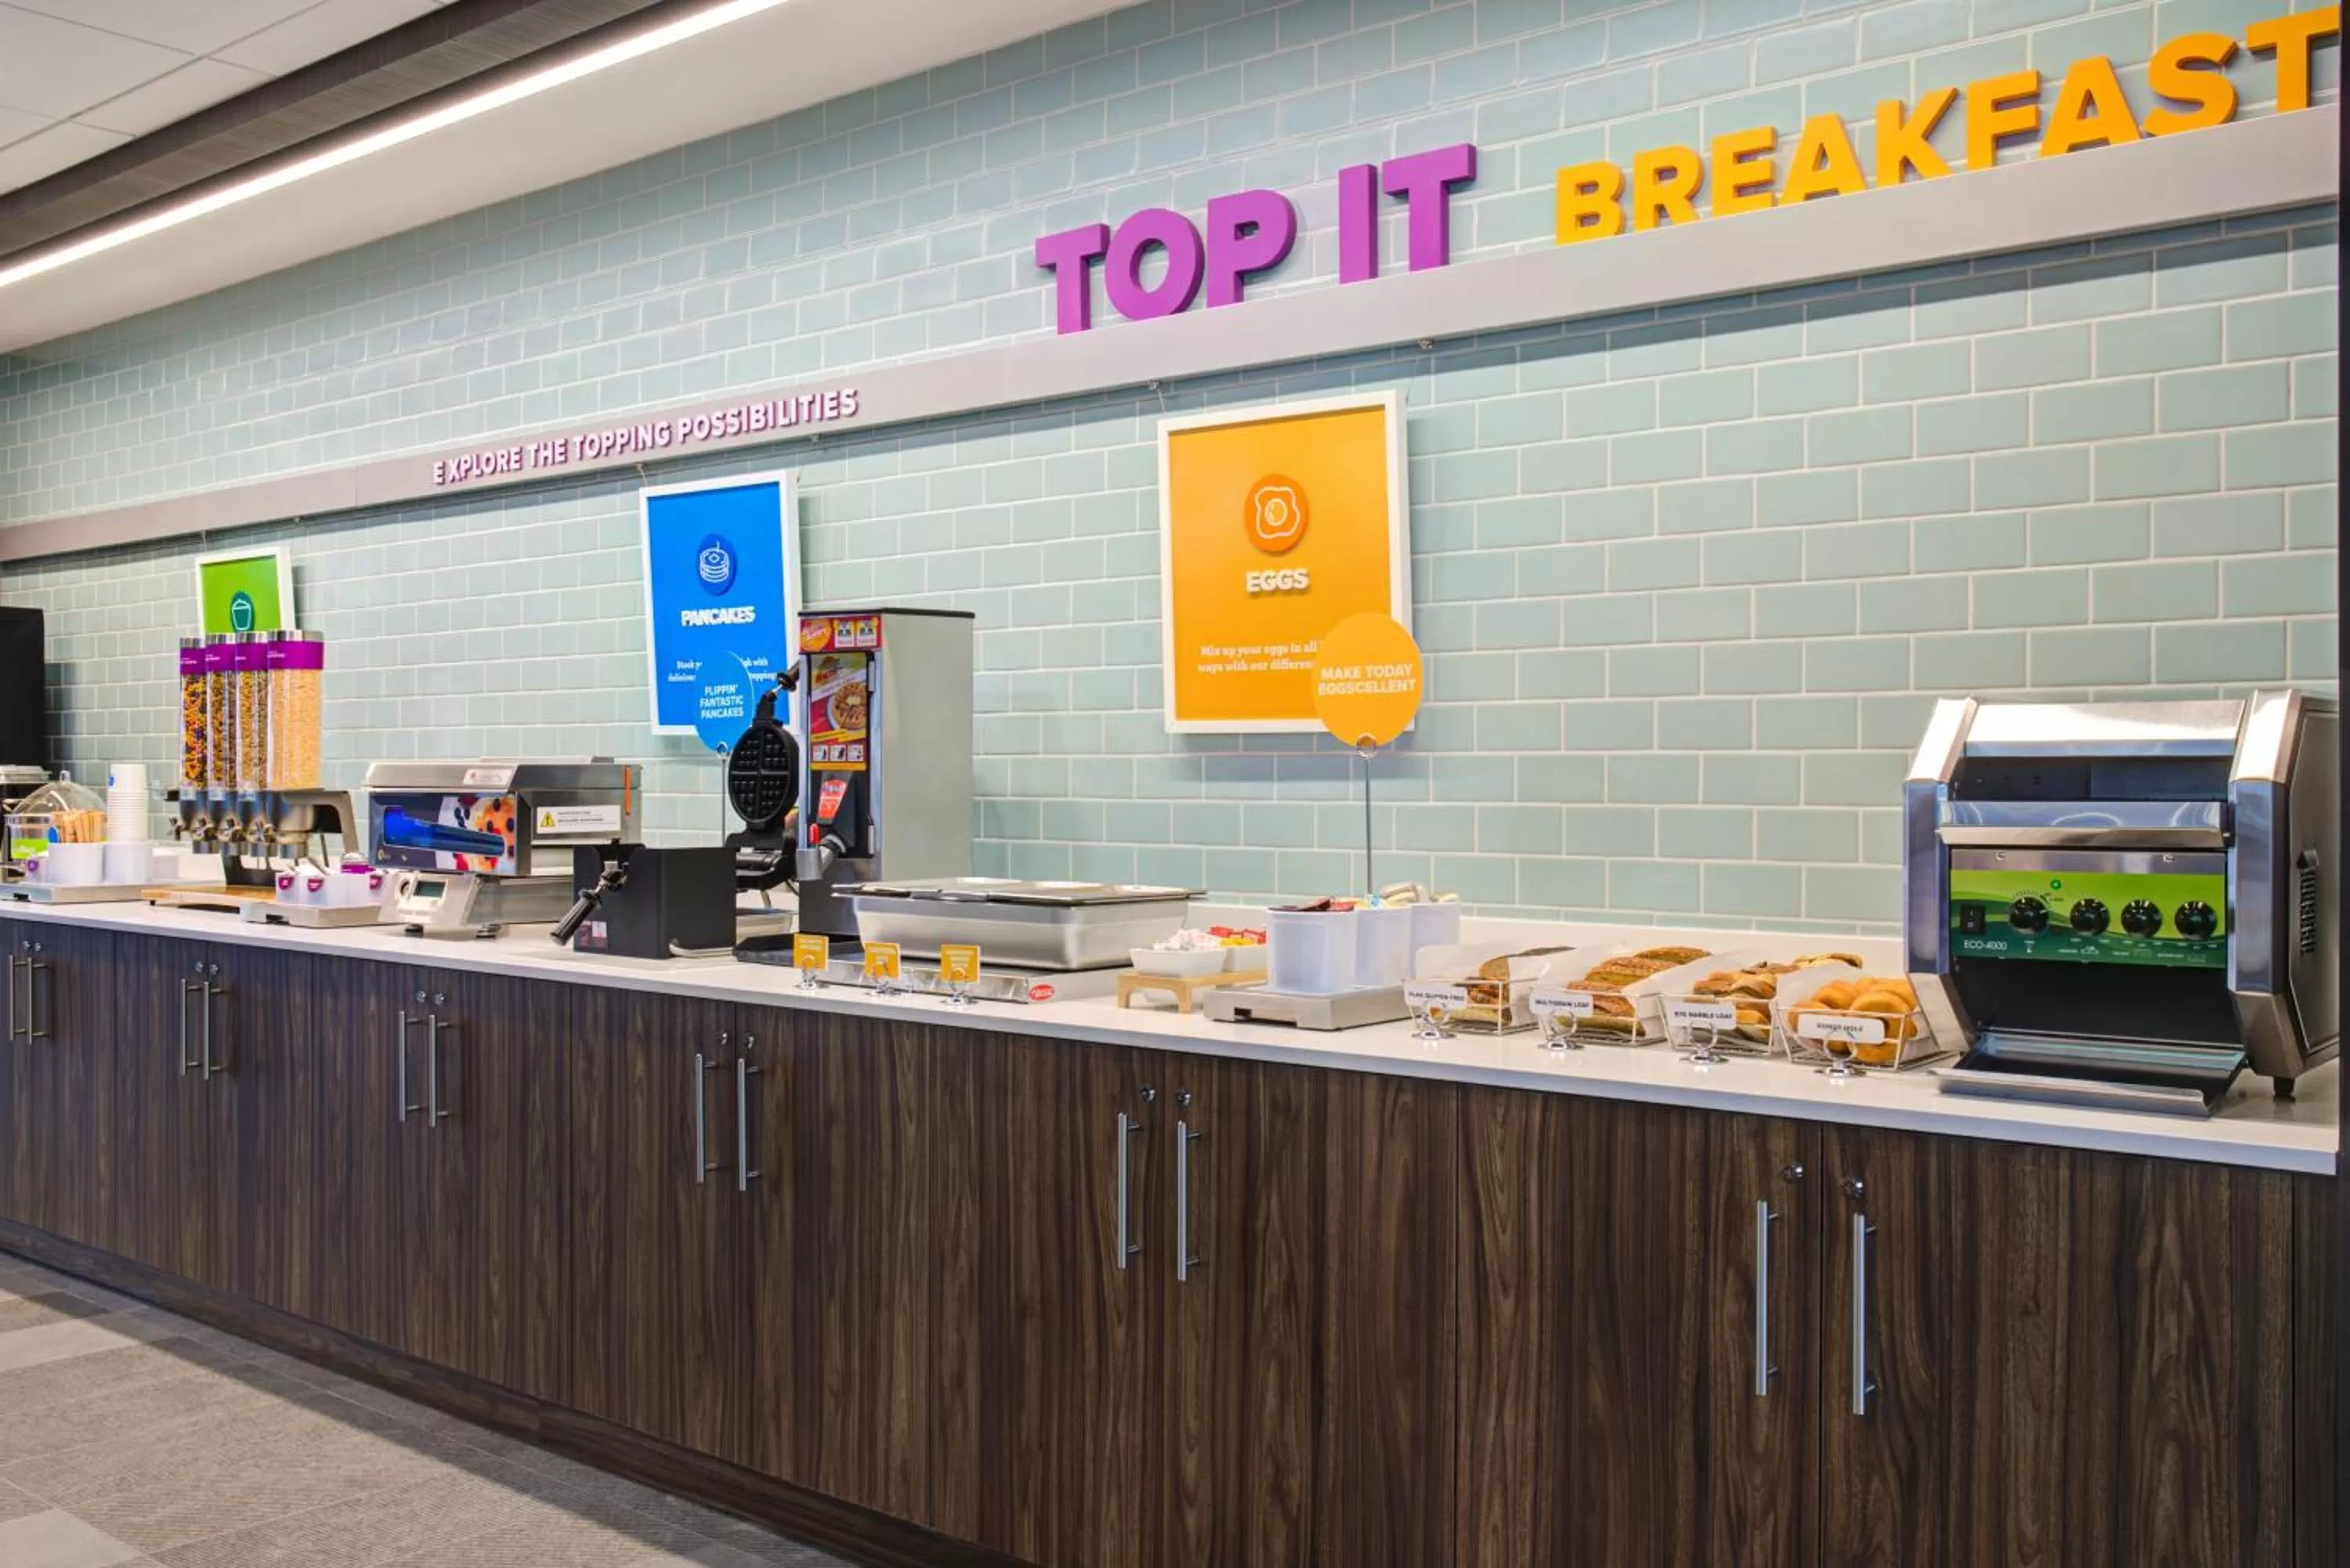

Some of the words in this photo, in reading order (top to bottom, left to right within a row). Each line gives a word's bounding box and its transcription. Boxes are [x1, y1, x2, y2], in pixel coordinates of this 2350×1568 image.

[1555, 4, 2340, 245] BREAKFAST
[1036, 189, 1297, 335] TOP
[1339, 143, 1477, 284] IT
[526, 435, 568, 468] THE
[573, 420, 673, 459] TOPPING
[677, 388, 860, 444] POSSIBILITIES
[1246, 569, 1310, 593] EGGS
[681, 605, 757, 627] PANCAKES
[1222, 647, 1235, 657] up
[1236, 645, 1262, 657] your
[1264, 645, 1288, 657] eggs
[1290, 642, 1302, 653] in
[1198, 661, 1224, 674] ways
[1225, 659, 1249, 671] with
[1250, 661, 1267, 671] our
[1321, 666, 1361, 681] MAKE
[1365, 664, 1413, 678] TODAY
[1318, 679, 1417, 696] EGGSCELLENT
[700, 695, 744, 708] FANTASTIC
[701, 706, 743, 719] PANCAKES
[1964, 940, 2008, 950] ECO-4000
